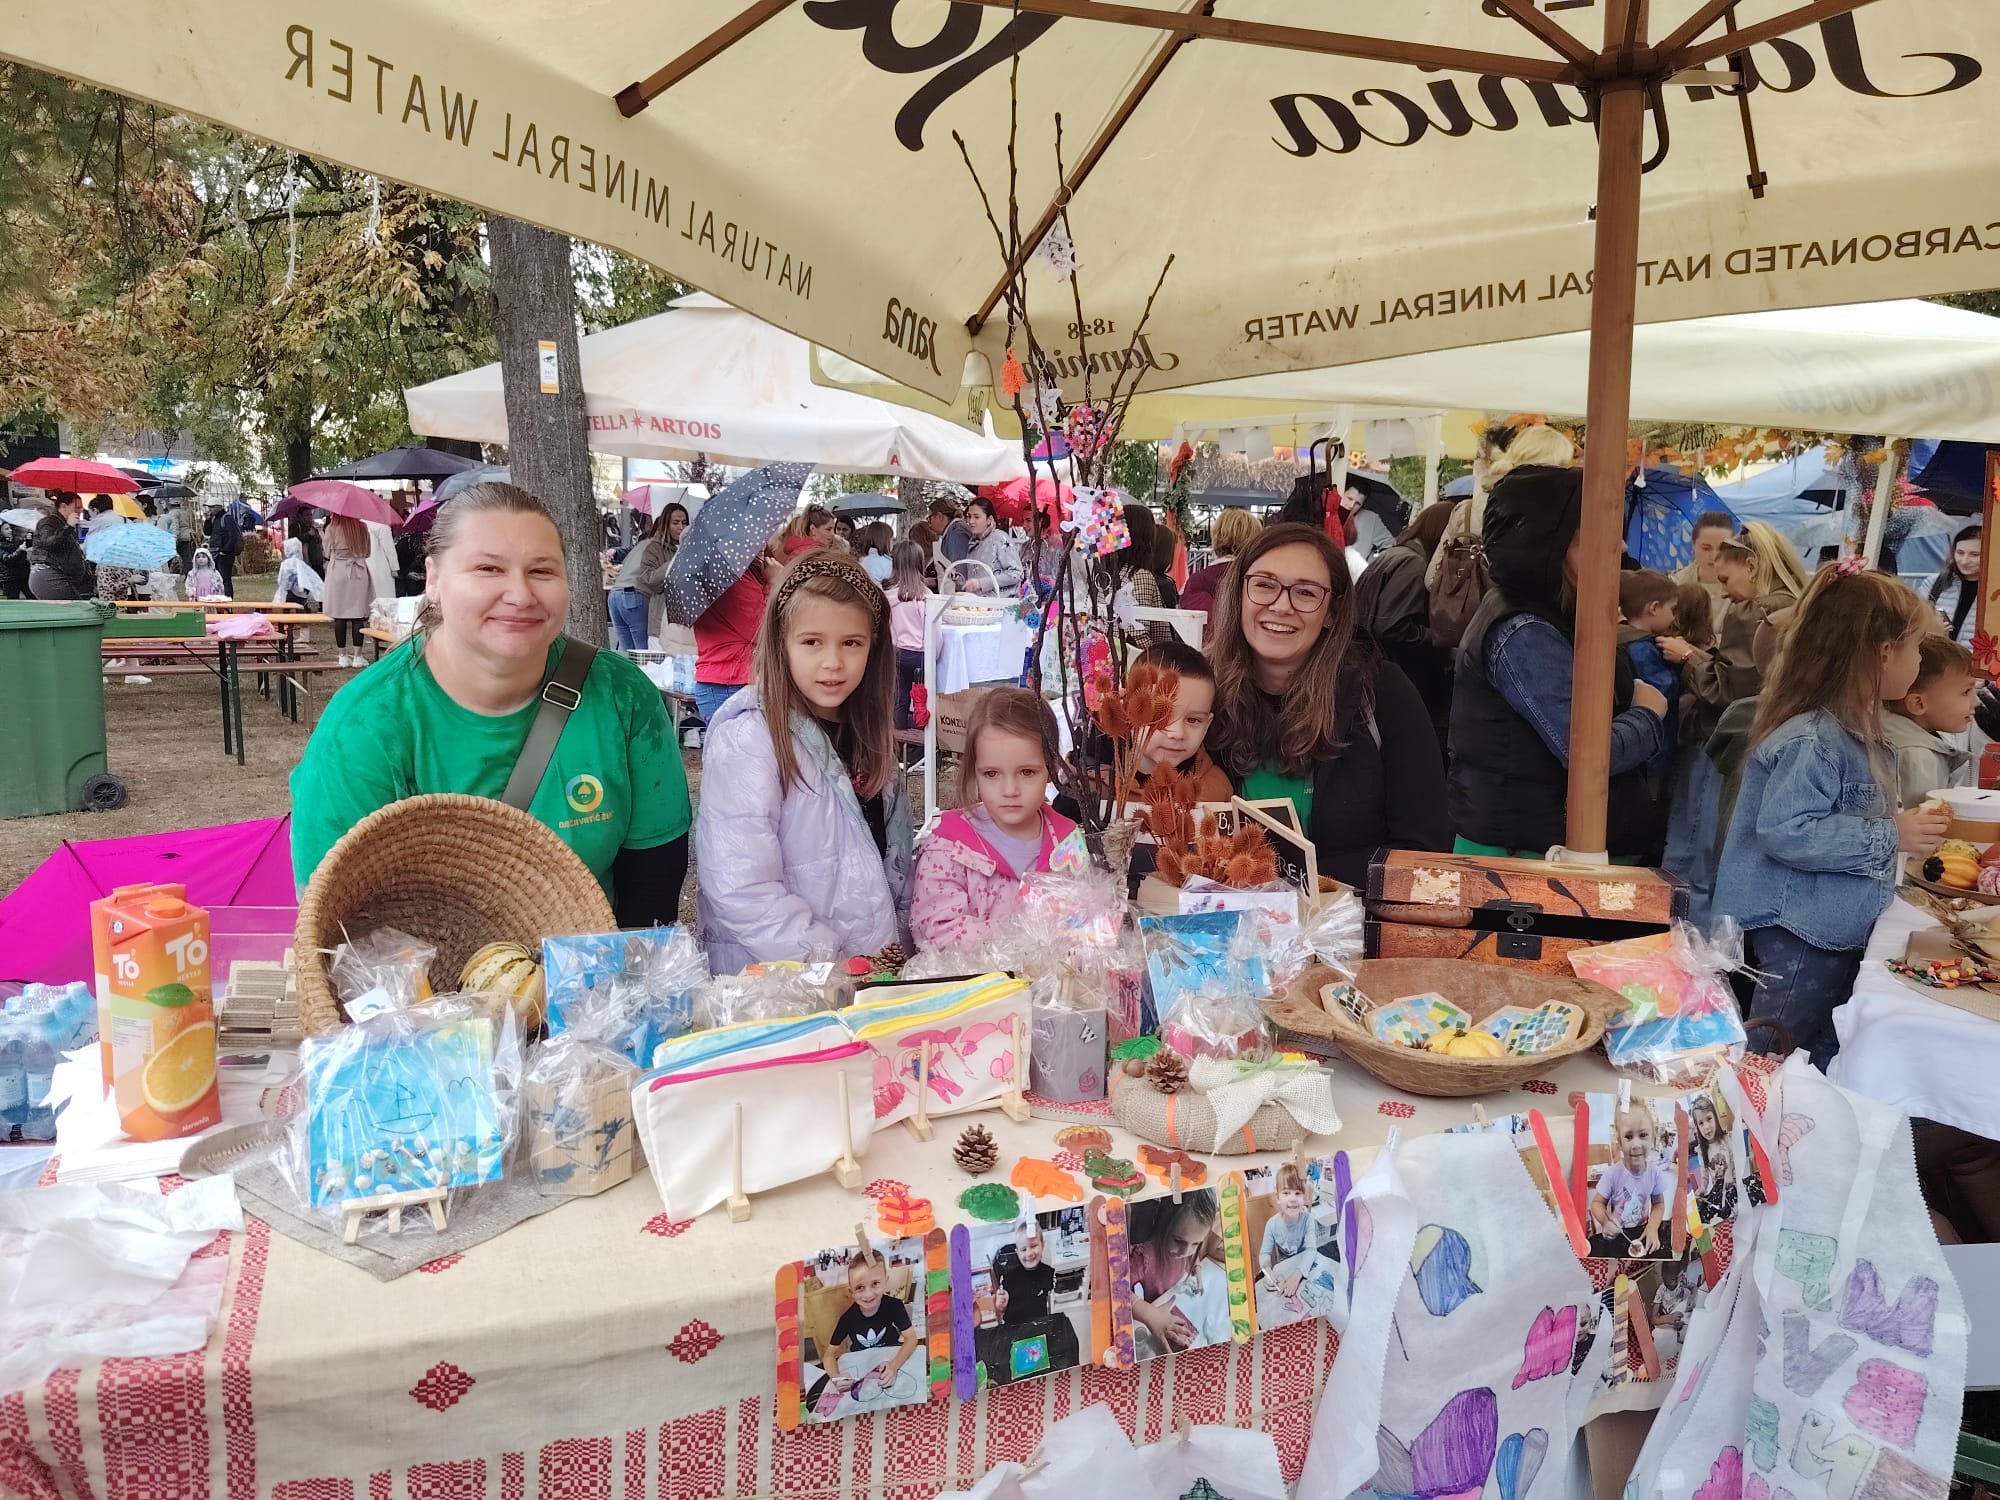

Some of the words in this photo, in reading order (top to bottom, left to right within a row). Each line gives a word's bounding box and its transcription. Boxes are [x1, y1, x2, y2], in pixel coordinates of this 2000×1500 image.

[586, 414, 627, 431] TELLA
[650, 415, 722, 440] ARTOIS
[940, 715, 967, 728] KONZU
